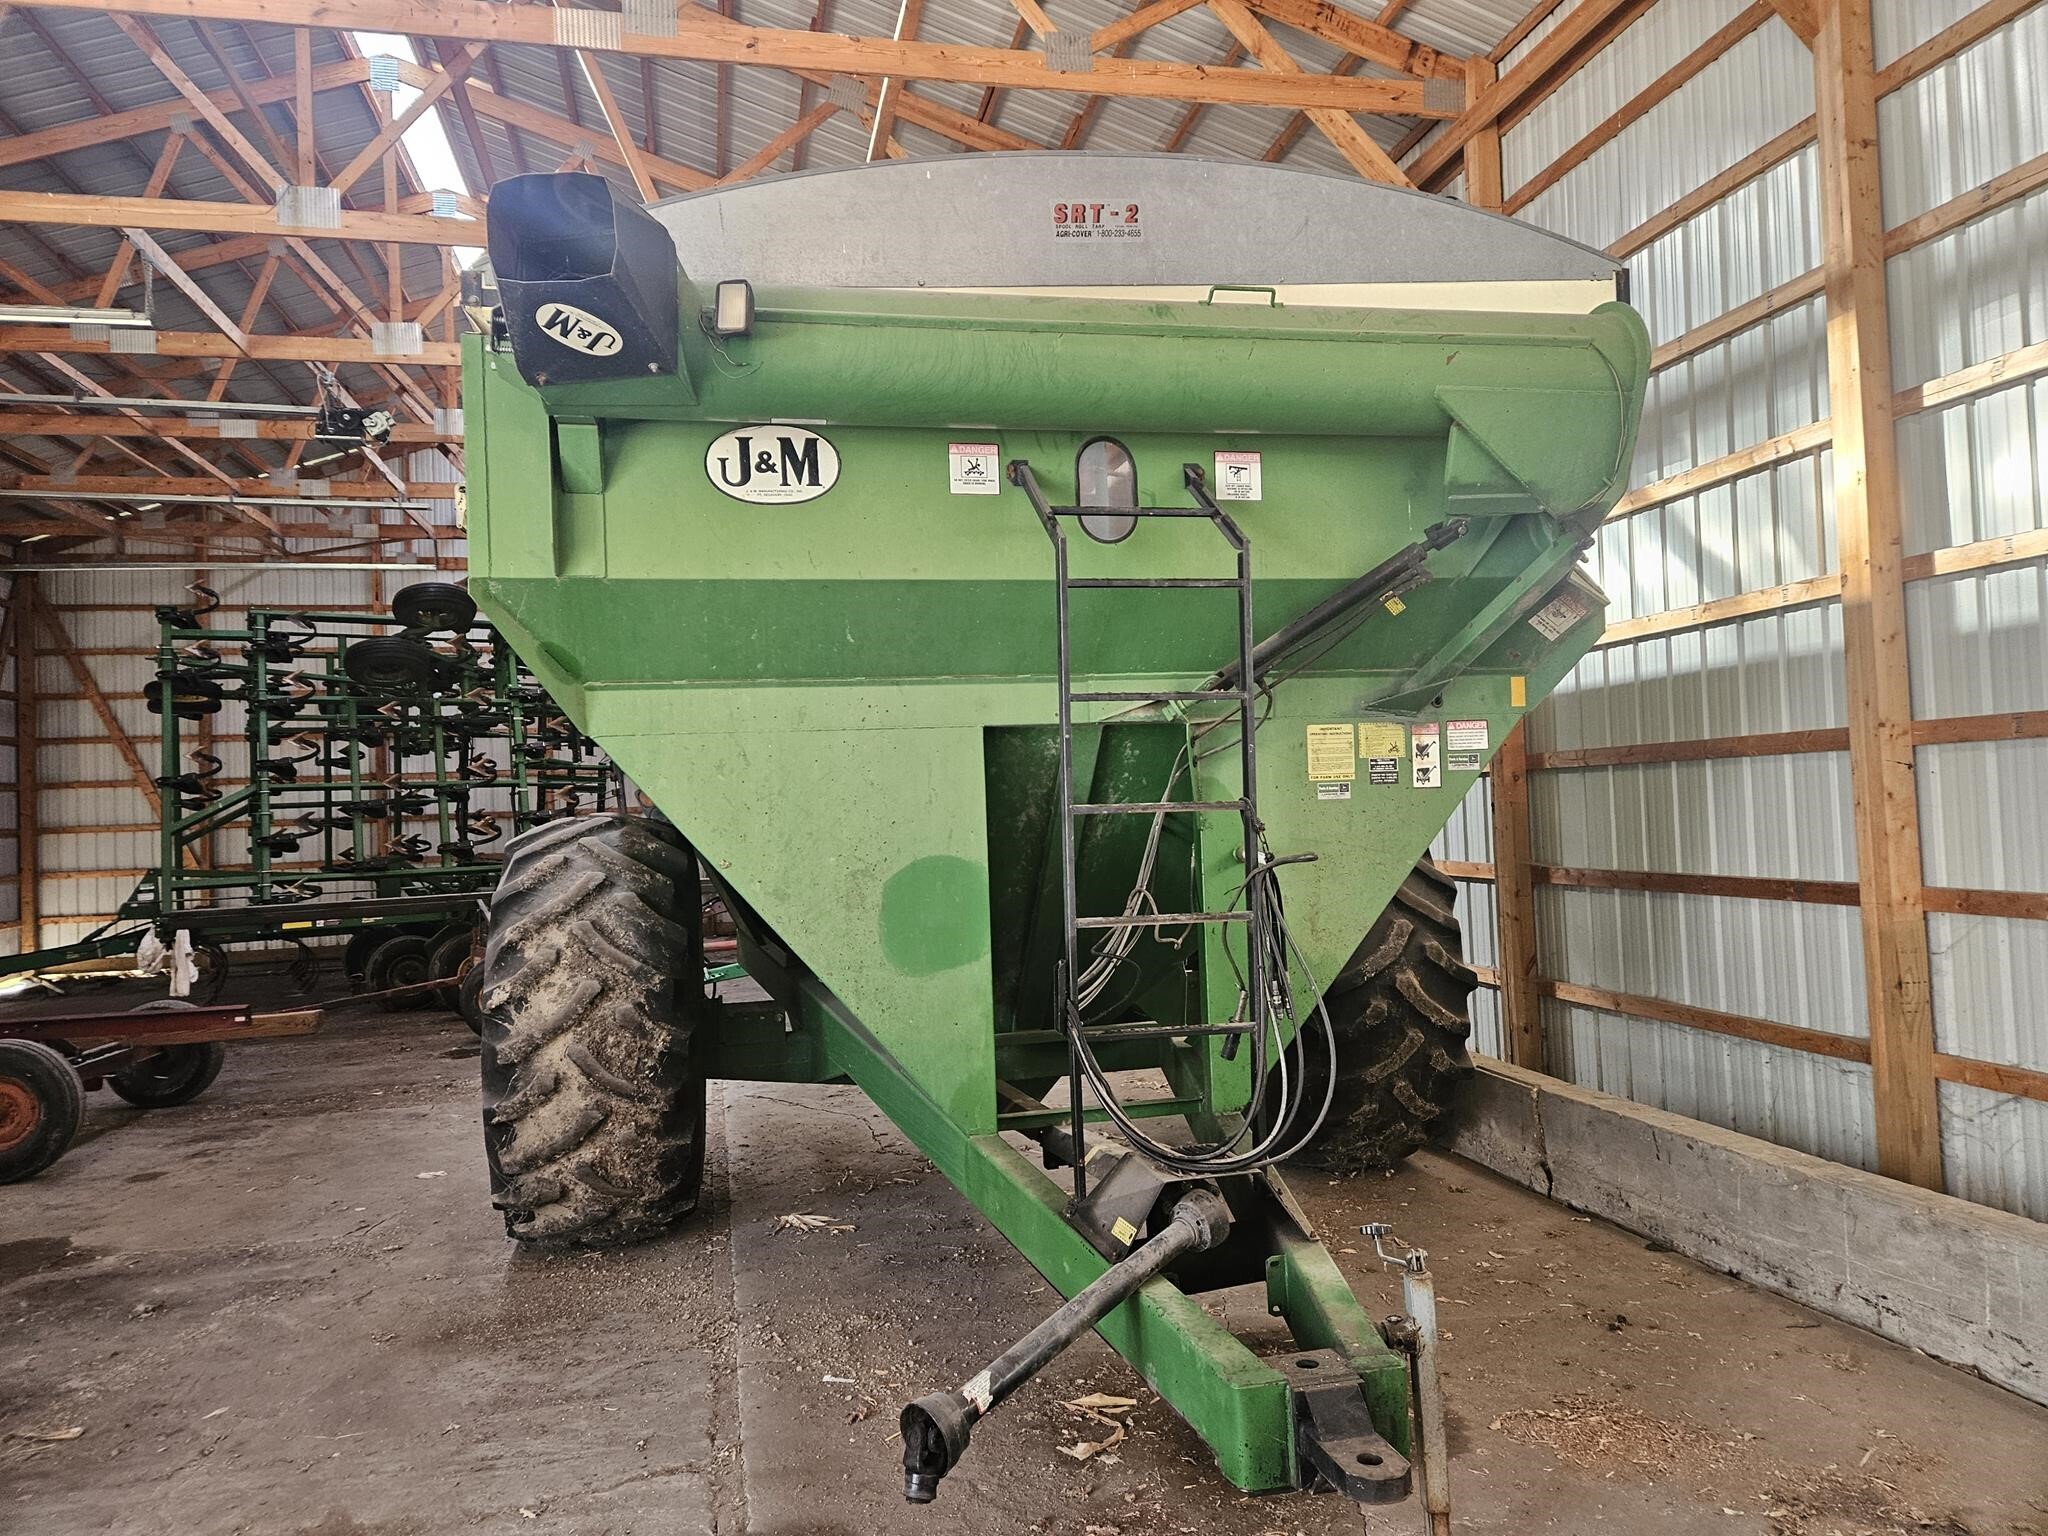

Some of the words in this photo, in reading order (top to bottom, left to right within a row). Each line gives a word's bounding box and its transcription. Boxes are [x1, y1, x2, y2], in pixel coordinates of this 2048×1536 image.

[1055, 230, 1092, 238] AGRI-COVER
[959, 445, 996, 454] DANGER
[1224, 453, 1258, 461] DANGER
[1456, 721, 1487, 729] DANGER
